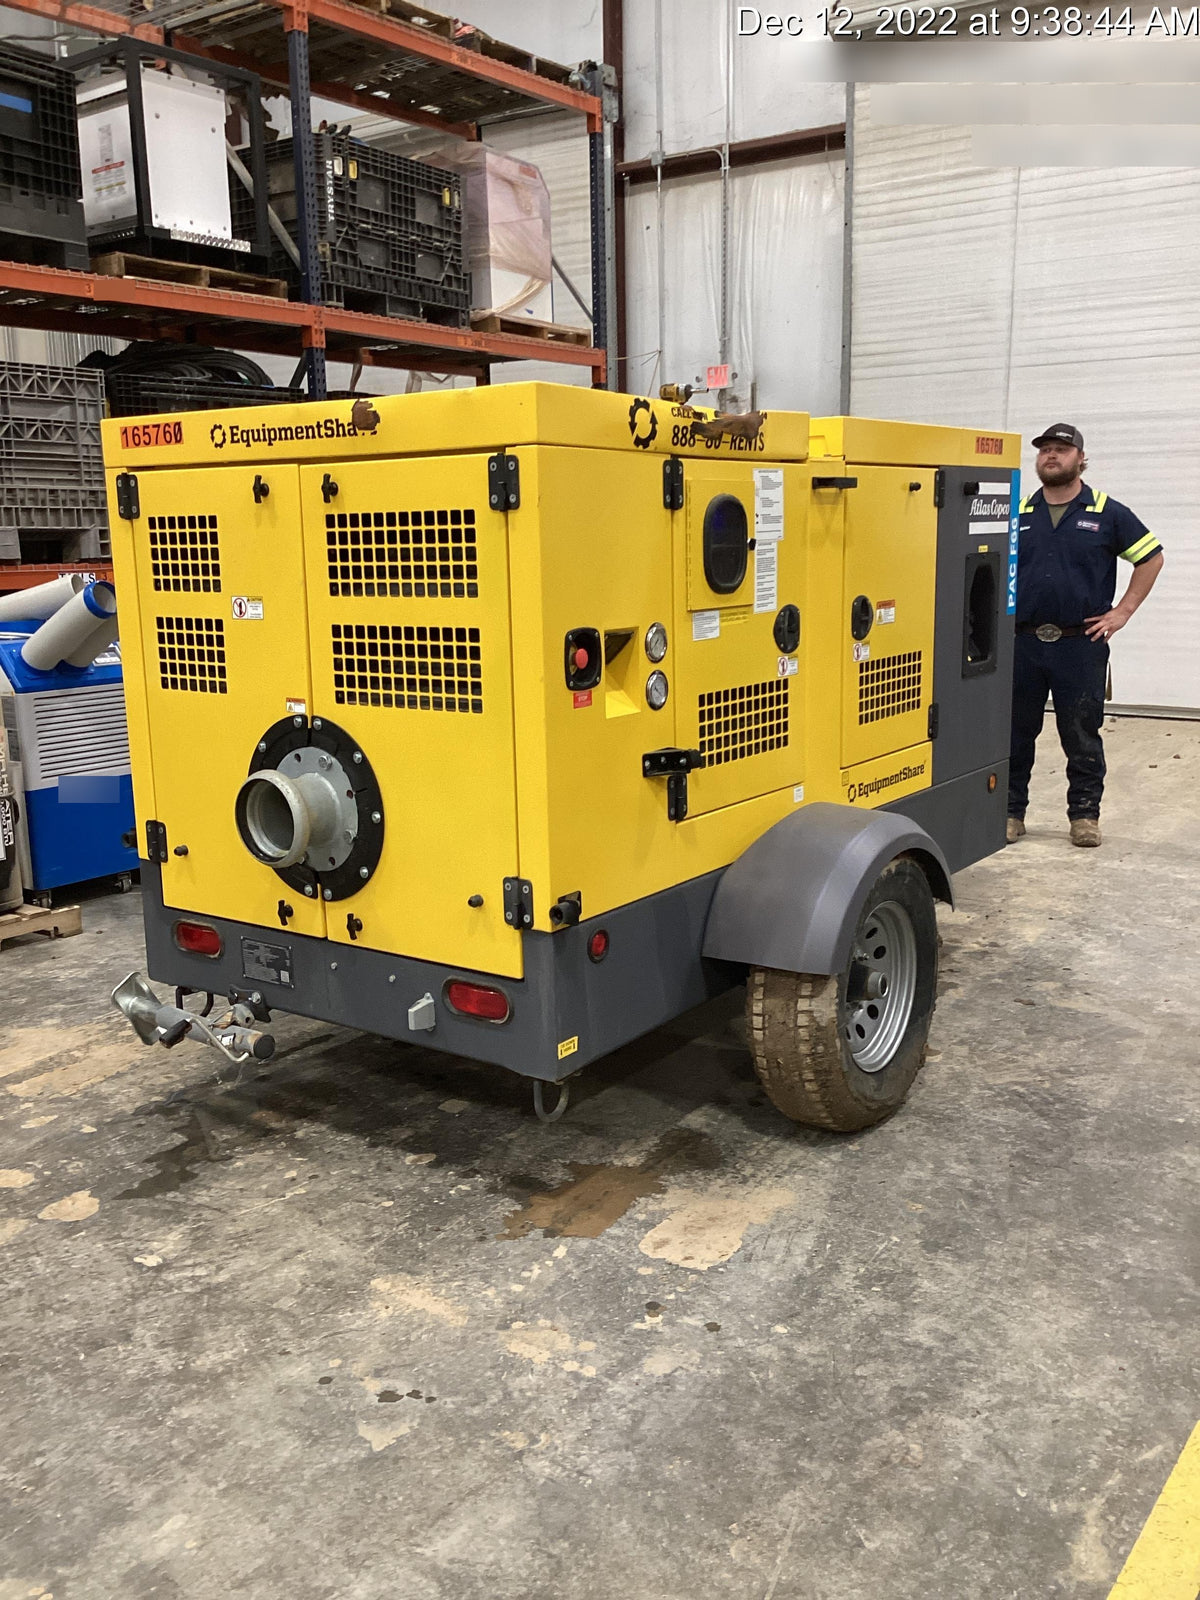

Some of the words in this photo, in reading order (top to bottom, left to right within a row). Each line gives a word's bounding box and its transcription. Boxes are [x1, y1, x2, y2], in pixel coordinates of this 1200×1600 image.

[325, 160, 335, 222] TRYSTAR
[122, 421, 183, 447] 165760
[230, 418, 377, 448] EquipmentSha
[969, 498, 990, 516] Atlas
[990, 498, 1010, 519] Copco
[1008, 563, 1016, 607] PAC
[858, 763, 926, 798] EquipmentShare
